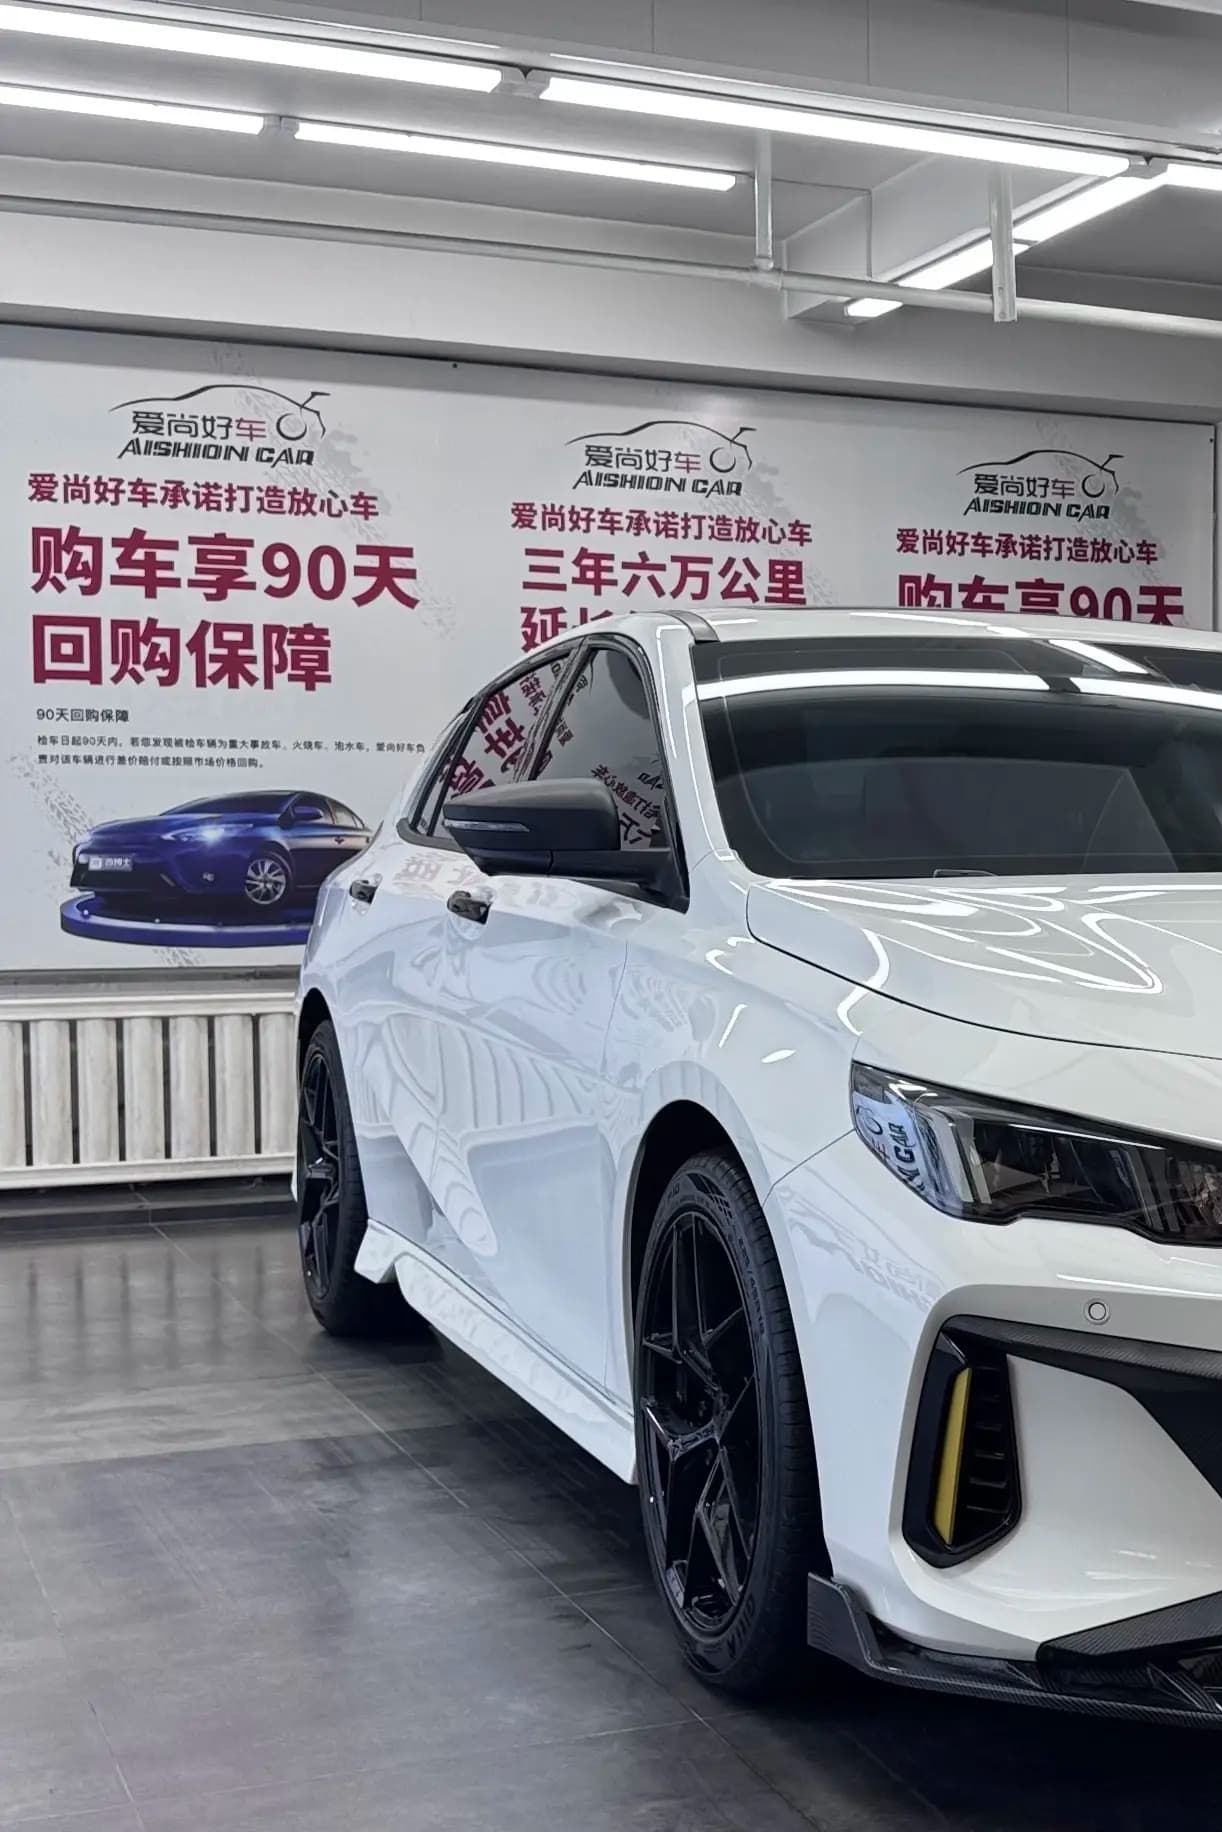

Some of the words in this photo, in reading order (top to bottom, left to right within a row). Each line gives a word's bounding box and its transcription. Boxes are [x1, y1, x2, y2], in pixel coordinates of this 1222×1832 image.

[132, 410, 267, 442] 爱尚好车
[118, 438, 249, 462] AISHION
[256, 446, 315, 468] CAR
[585, 444, 701, 474] 爱尚好车
[28, 473, 379, 520] 爱尚好车承诺打造放心车
[572, 470, 686, 493] AISHION
[692, 479, 743, 498] CAR
[973, 473, 1075, 499] 爱尚好车
[511, 502, 812, 547] 爱尚好车承诺打造放心车
[963, 497, 1062, 517] AISHION
[1066, 503, 1110, 522] CAR
[896, 528, 1158, 565] 爱尚好车承诺打造放心车
[31, 525, 420, 609] 购车享90天
[522, 547, 806, 606] 三年六万公里
[33, 614, 333, 691] 回购保障
[36, 707, 130, 724] 90天回购保障
